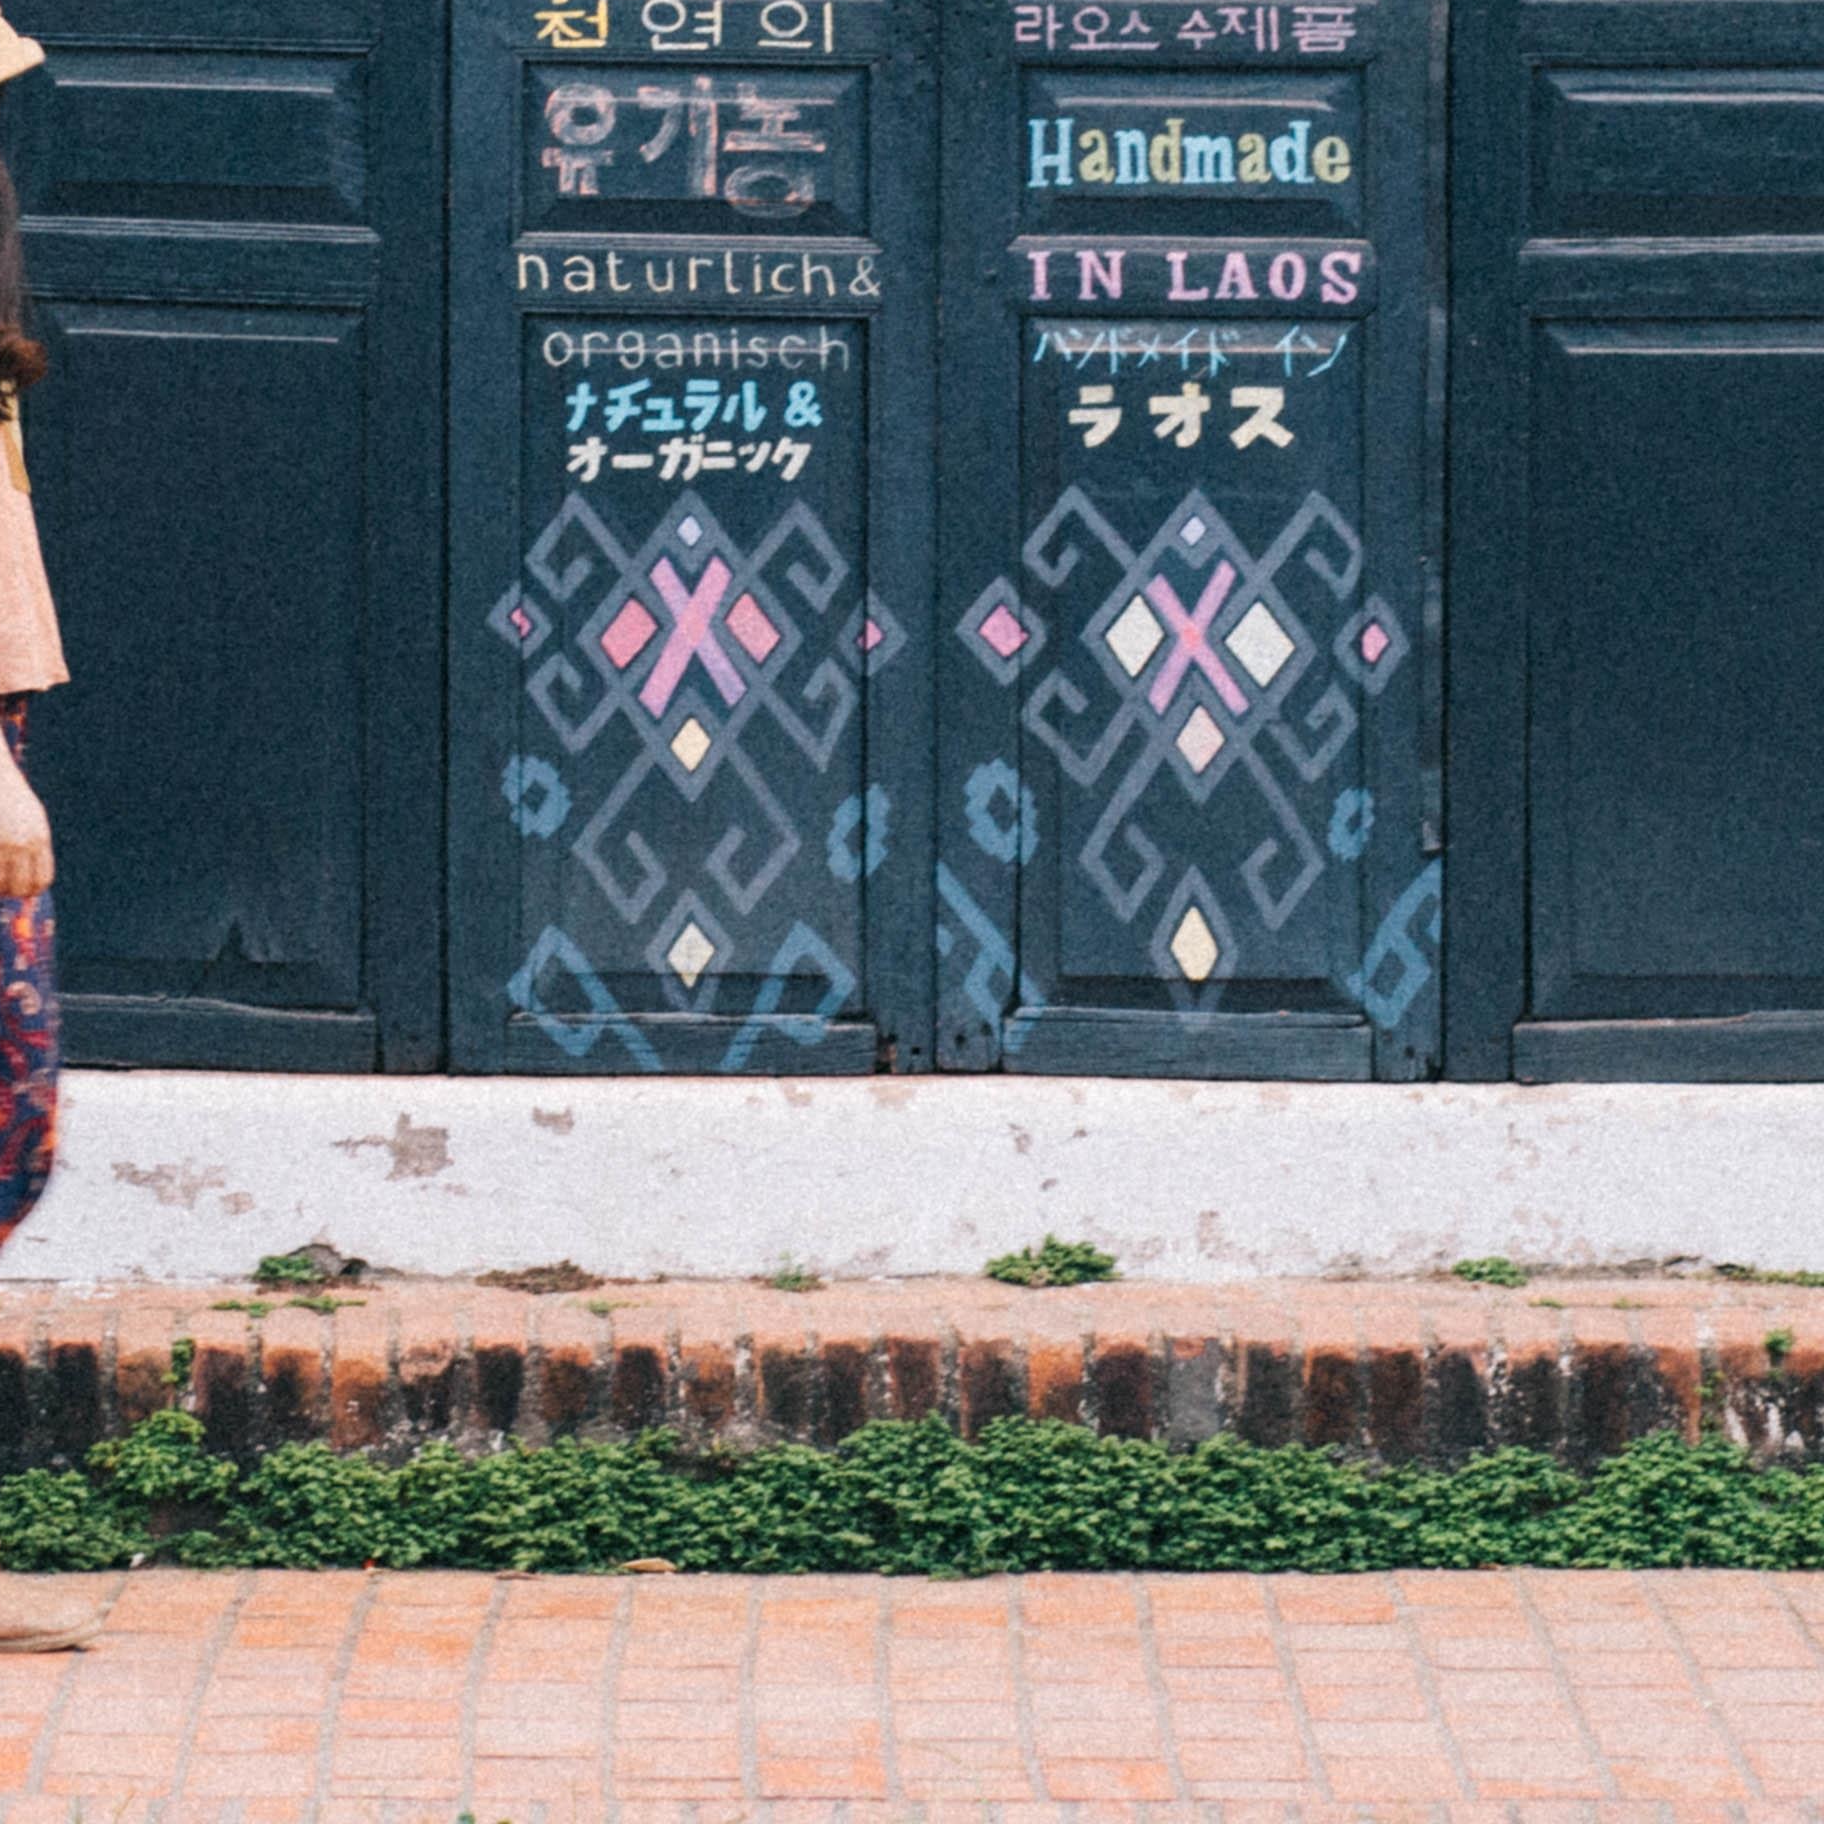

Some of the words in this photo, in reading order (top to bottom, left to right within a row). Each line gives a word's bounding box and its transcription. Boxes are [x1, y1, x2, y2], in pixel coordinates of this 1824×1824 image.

[1014, 5, 1161, 52] 라오스
[541, 76, 826, 219] 유기농
[1027, 117, 1352, 188] Handmade
[517, 250, 837, 297] naturlich
[848, 255, 881, 296] &
[1027, 249, 1126, 301] IN
[1166, 251, 1362, 304] LAOS
[543, 326, 850, 371] organisch
[566, 378, 766, 432] ナチュラル
[784, 381, 823, 428] &
[1068, 381, 1295, 450] ラオス
[566, 433, 812, 483] オーガニック
